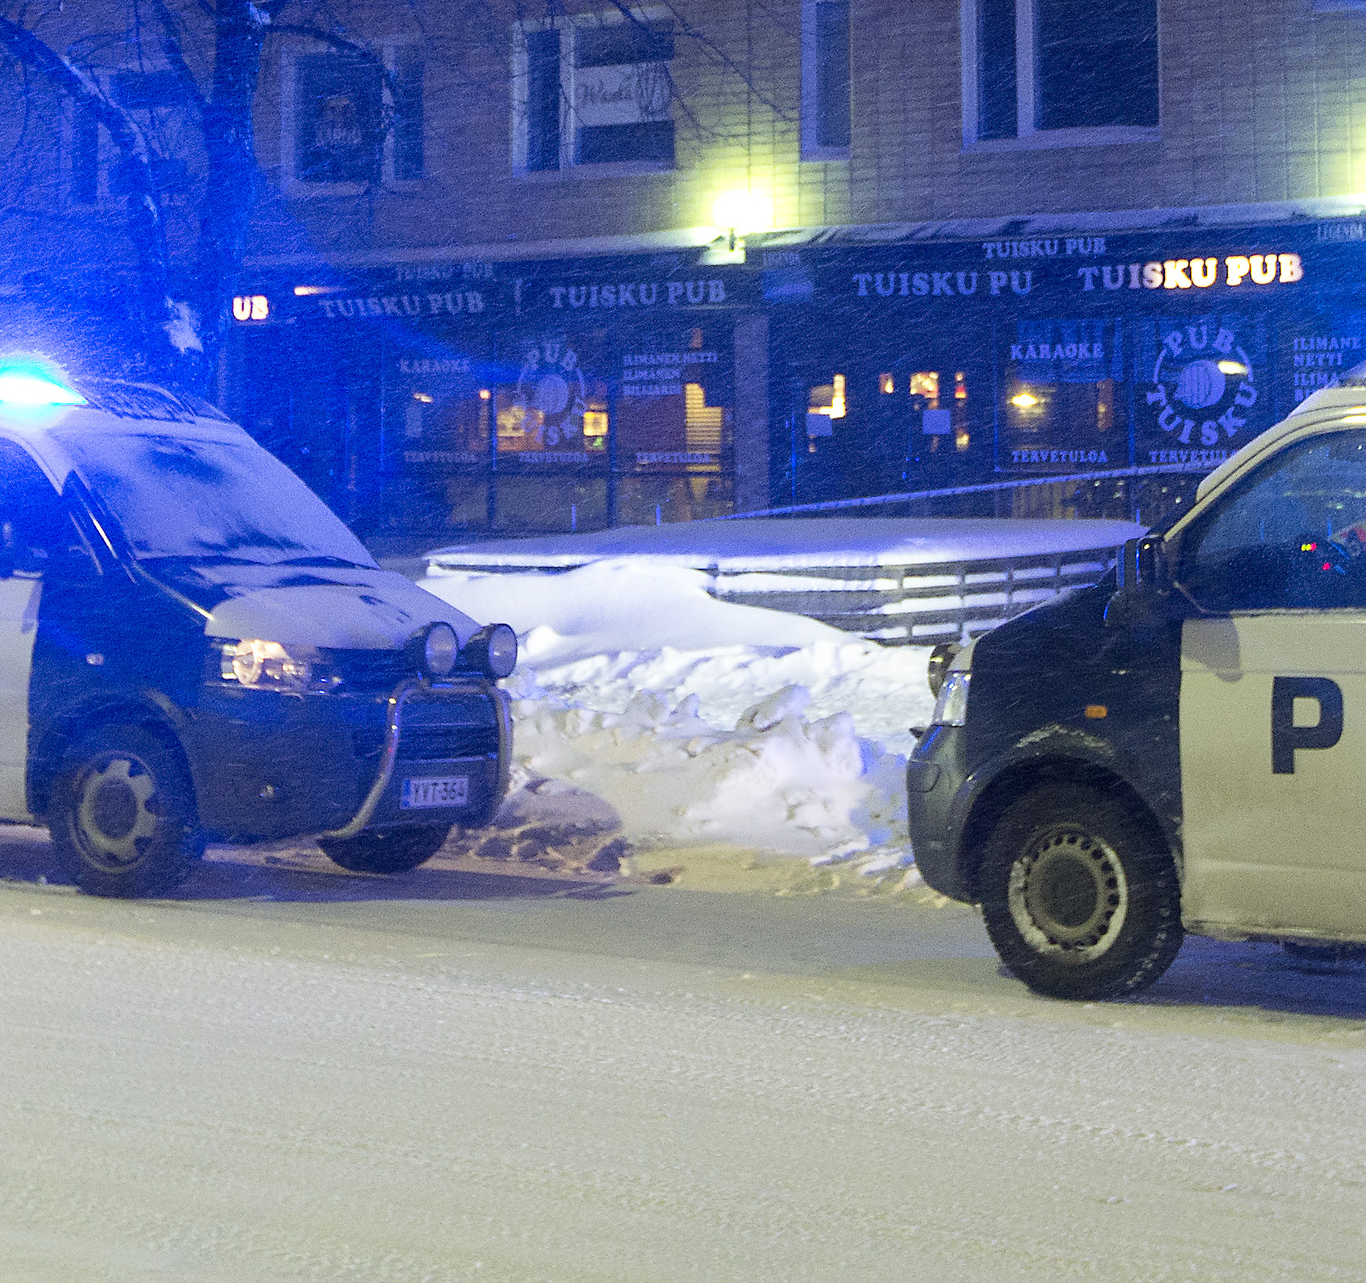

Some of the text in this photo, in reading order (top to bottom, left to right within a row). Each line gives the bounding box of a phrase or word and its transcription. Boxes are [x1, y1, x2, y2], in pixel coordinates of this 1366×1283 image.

[983, 237, 1106, 258] TUISKU PUB
[853, 270, 1033, 296] TUISKU PU
[1078, 253, 1303, 290] TUISKU PUB
[318, 291, 484, 318] TUISKU PUB
[549, 279, 727, 308] TUISKU PUB
[232, 294, 269, 321] UB
[1011, 342, 1105, 360] KARAOKE
[1164, 324, 1234, 356] PUB
[1294, 337, 1363, 351] ILIMANE
[399, 359, 471, 374] KARAOKE
[526, 341, 578, 372] PUB
[1294, 352, 1343, 367] NETTI
[1294, 372, 1339, 386] ILIMA
[514, 395, 588, 446] TUISKU
[1146, 381, 1257, 446] TUISKU
[1011, 450, 1108, 464] TERVETULOA
[1148, 450, 1237, 463] TERVETUL
